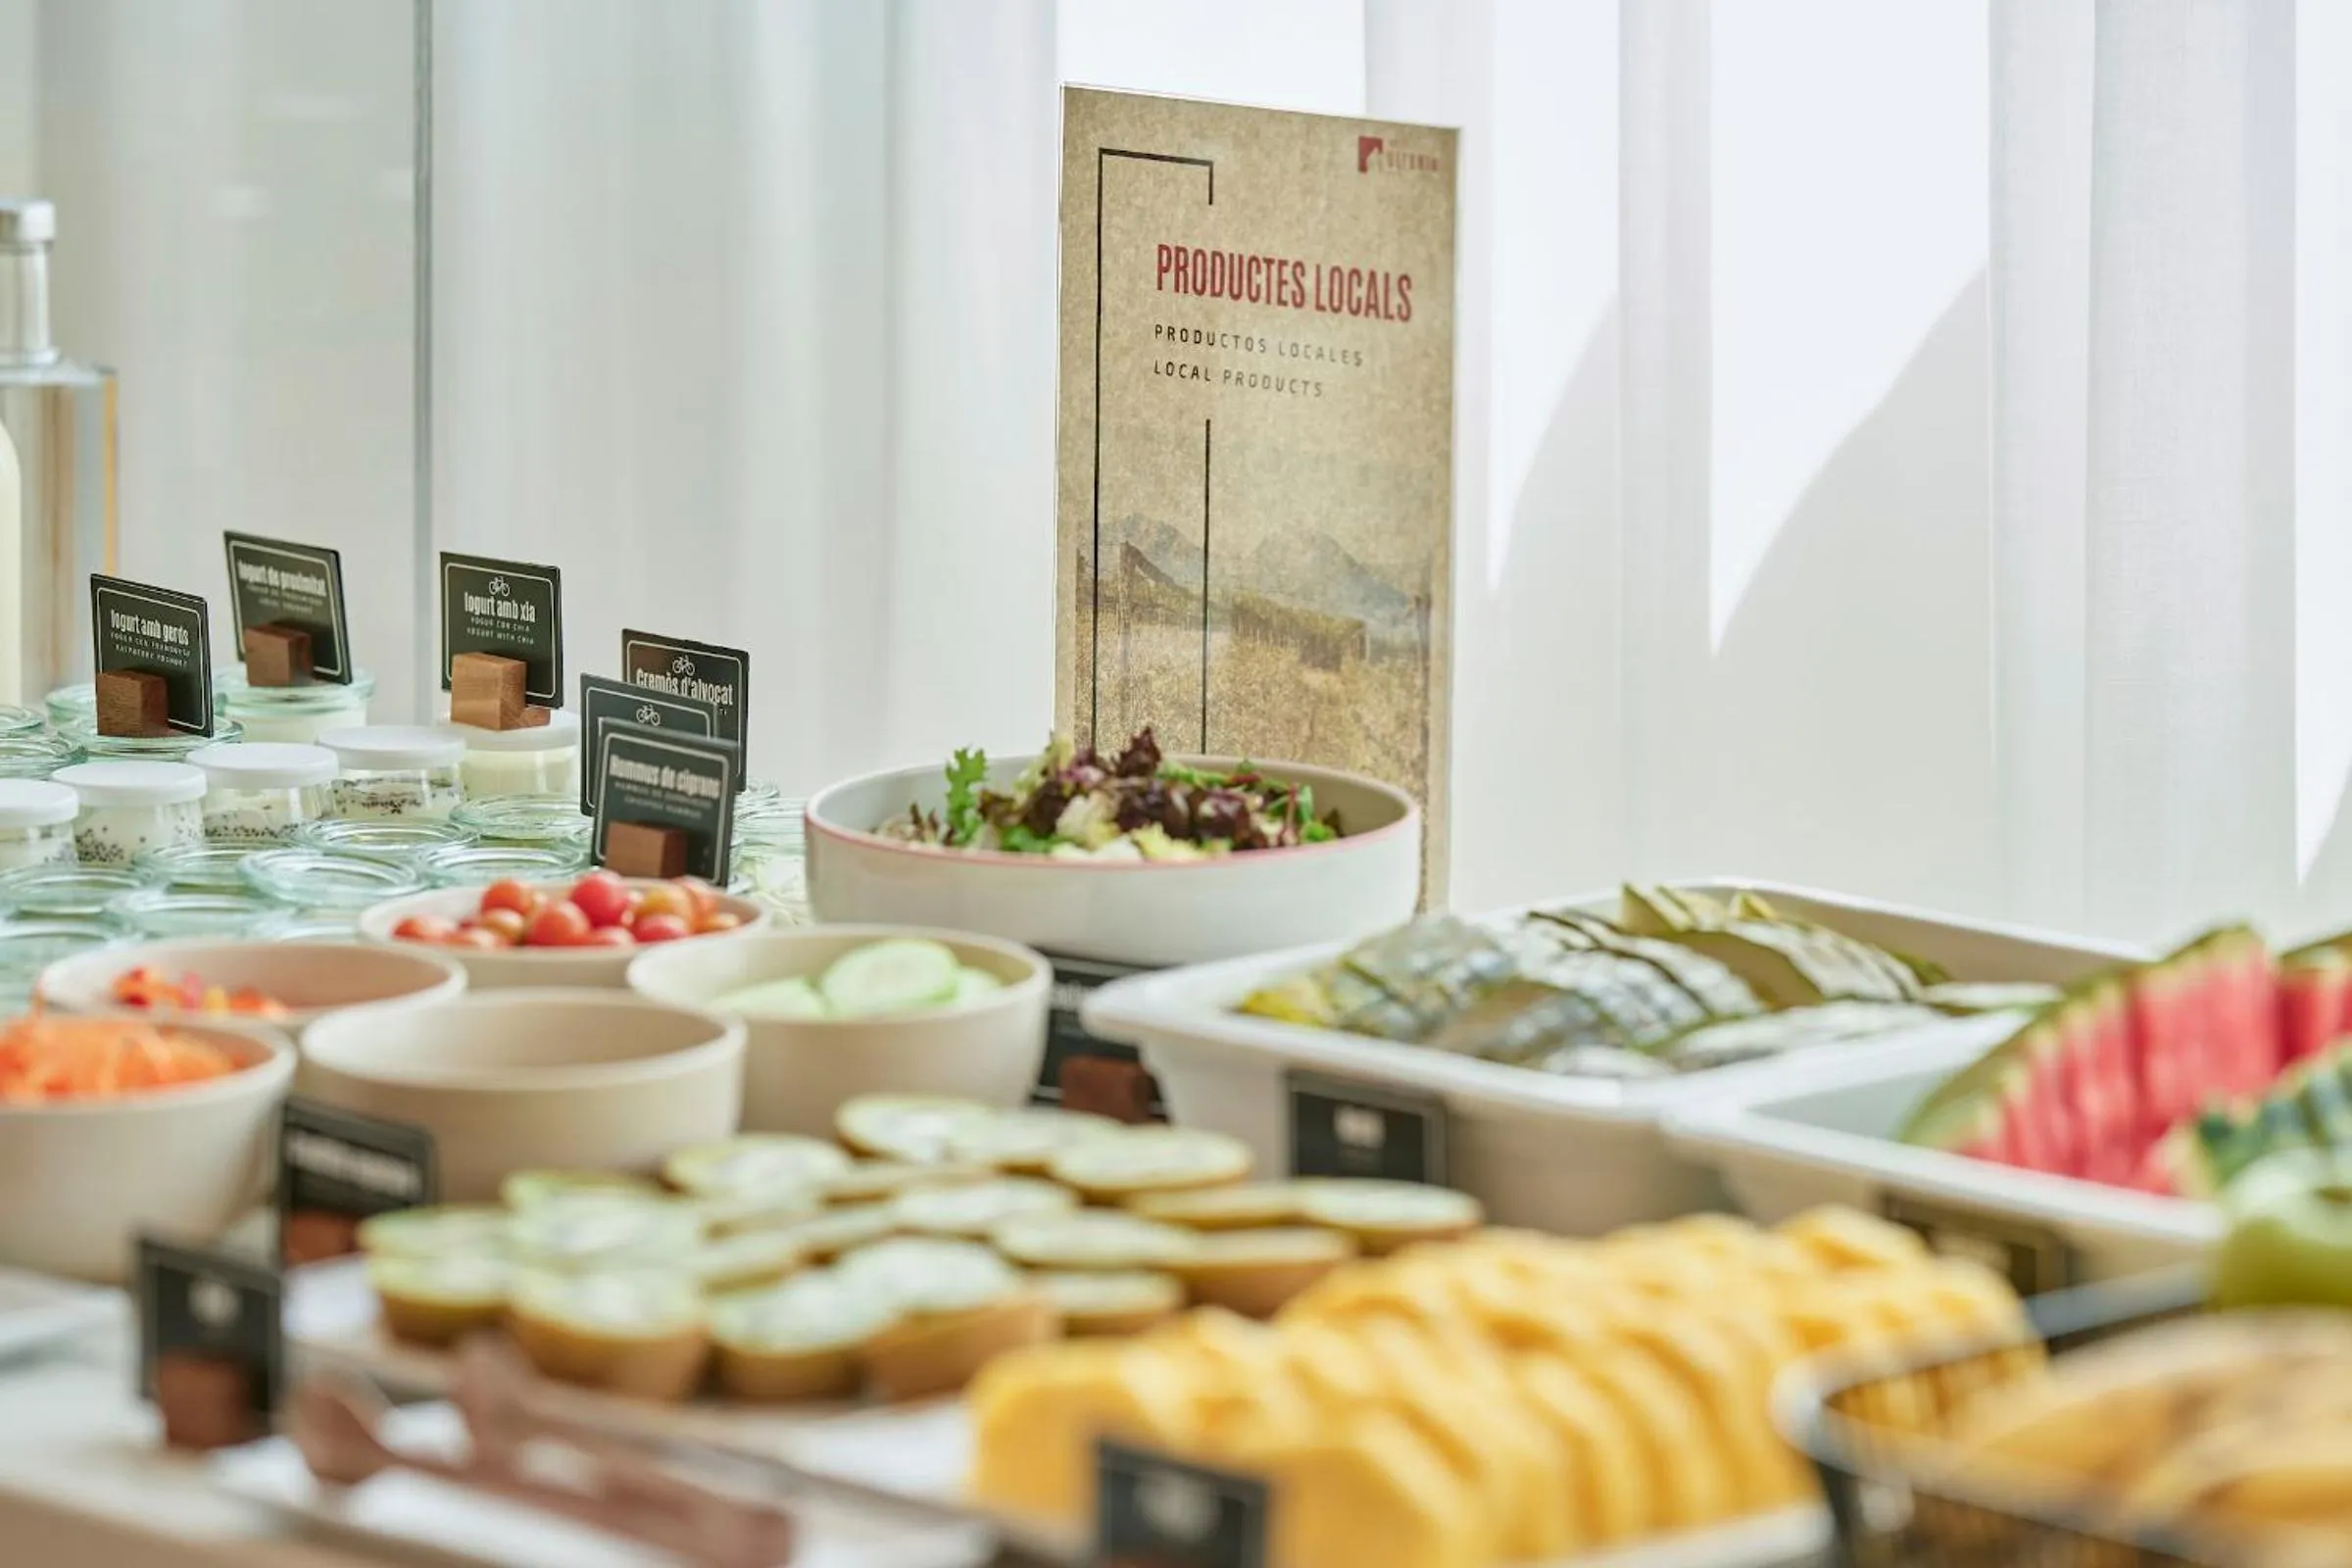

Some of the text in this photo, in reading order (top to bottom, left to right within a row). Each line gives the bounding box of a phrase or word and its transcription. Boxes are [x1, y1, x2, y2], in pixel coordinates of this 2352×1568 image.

[1156, 243, 1412, 322] PRODUCTES LOCALS
[1154, 323, 1363, 368] PRODUCTOS LOCALES
[1153, 359, 1322, 398] LOCAL PRODUCTS
[464, 591, 535, 623] Iogurt amb xia
[111, 609, 189, 646] Iogurt amb gerds
[681, 676, 733, 706] d'alvocat
